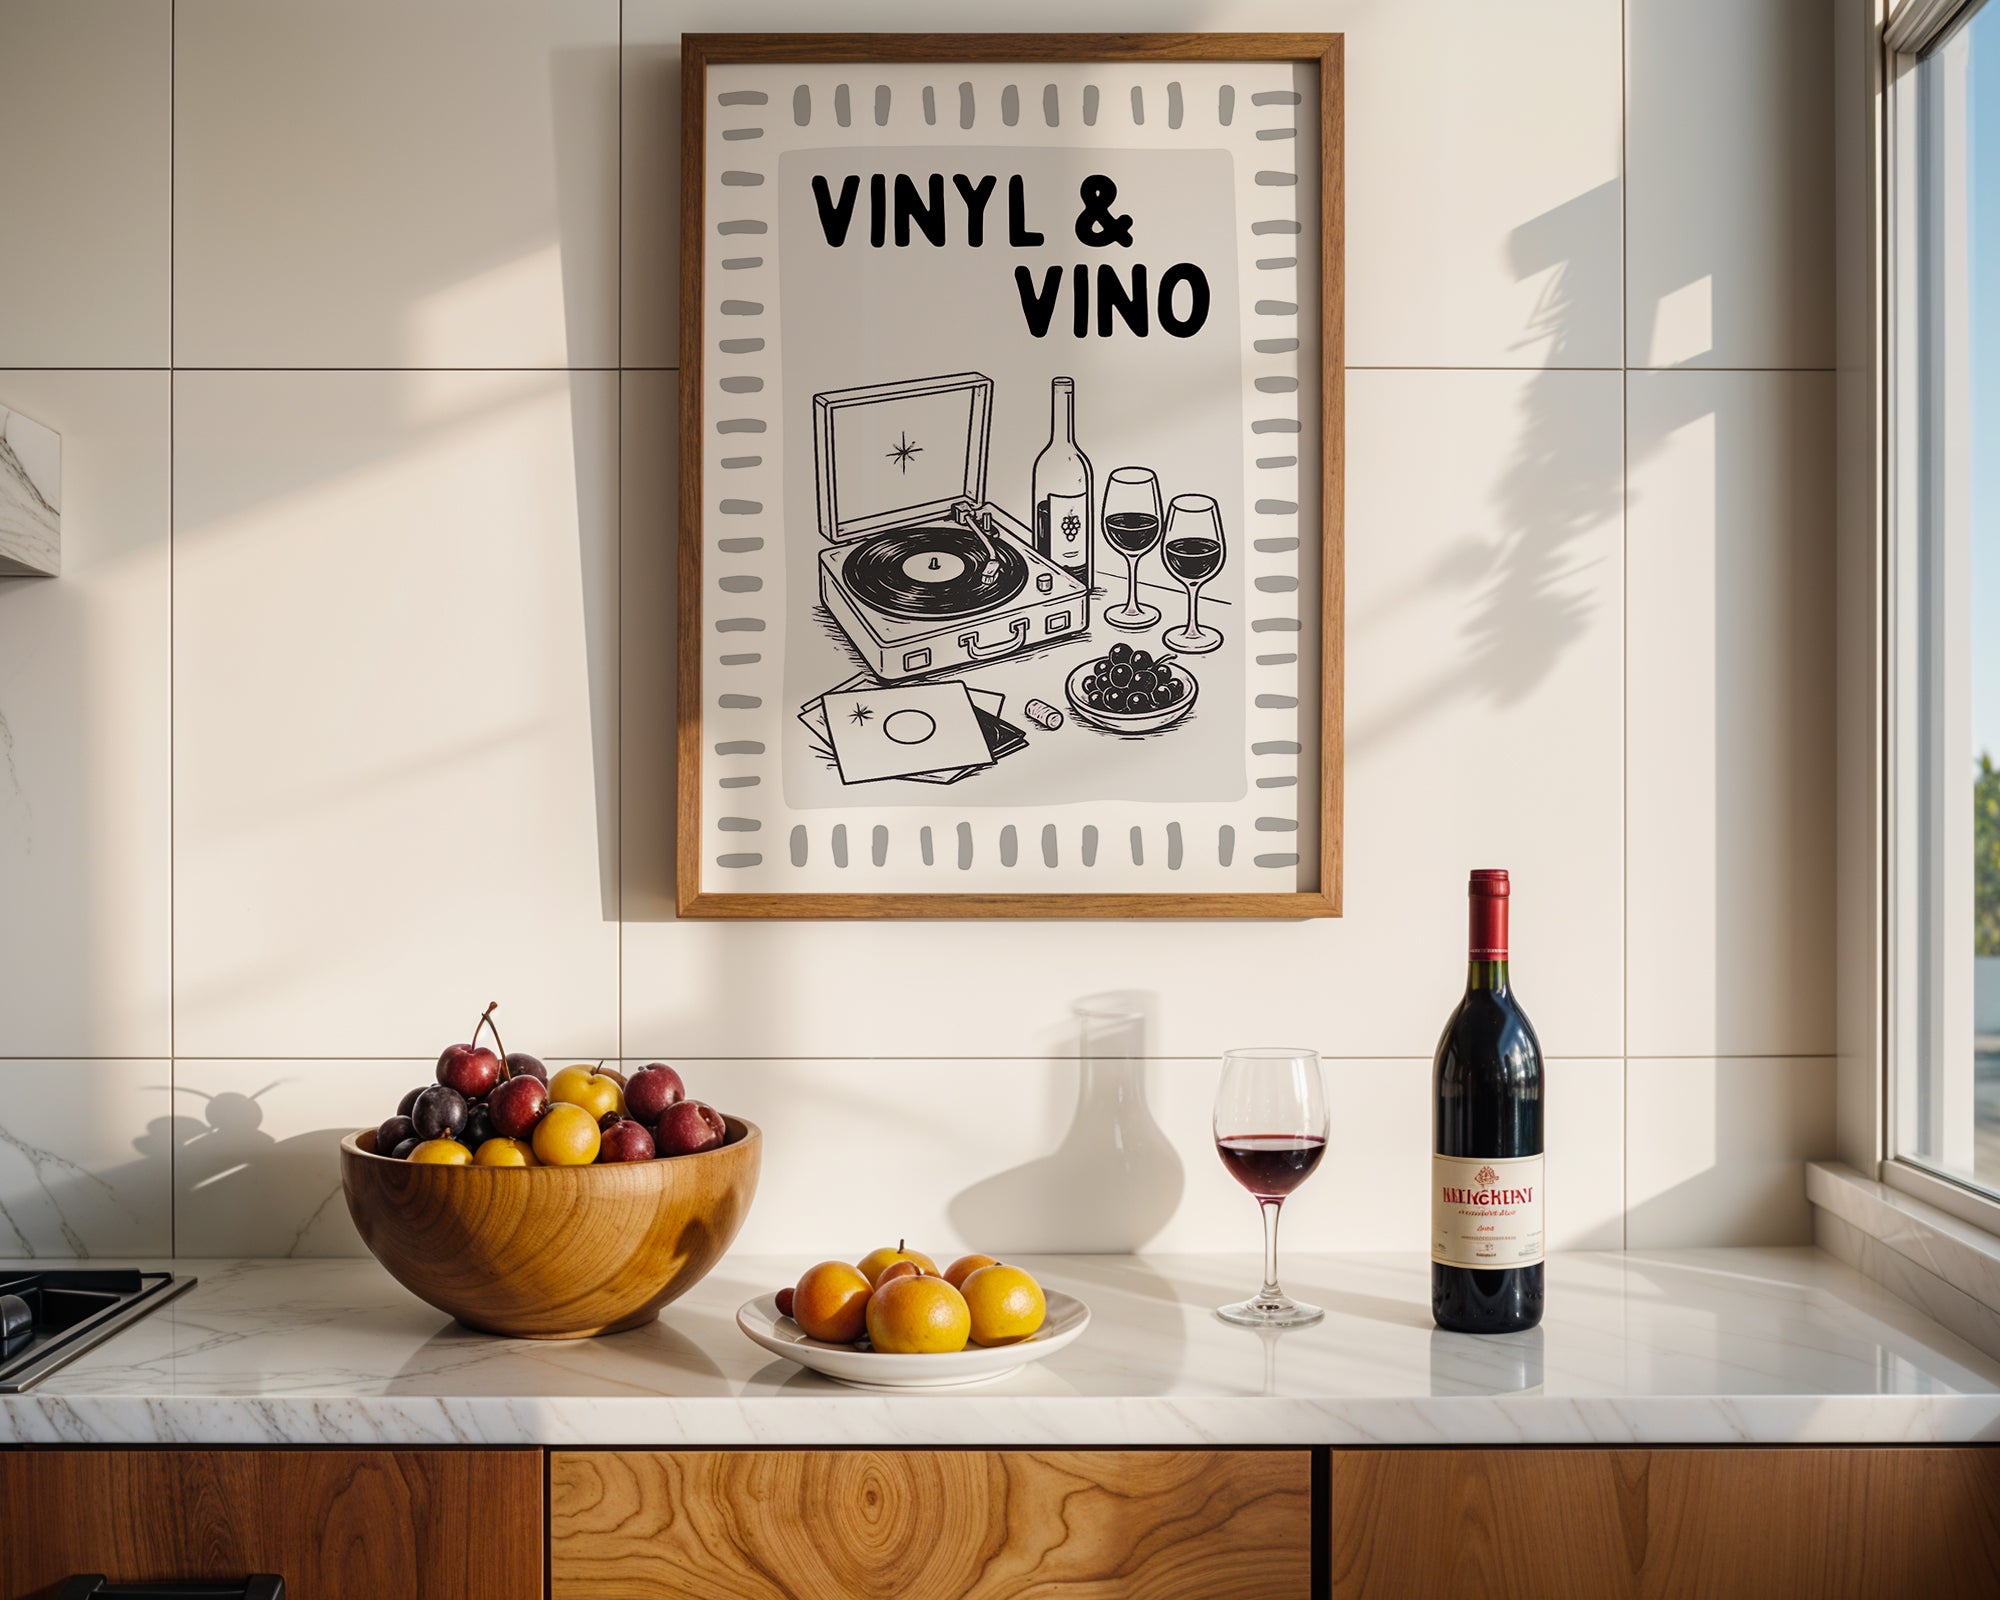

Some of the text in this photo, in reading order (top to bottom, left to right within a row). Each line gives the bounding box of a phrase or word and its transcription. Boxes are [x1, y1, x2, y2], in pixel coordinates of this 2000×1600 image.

[812, 174, 1133, 248] VINYL &
[1015, 263, 1210, 338] VINO
